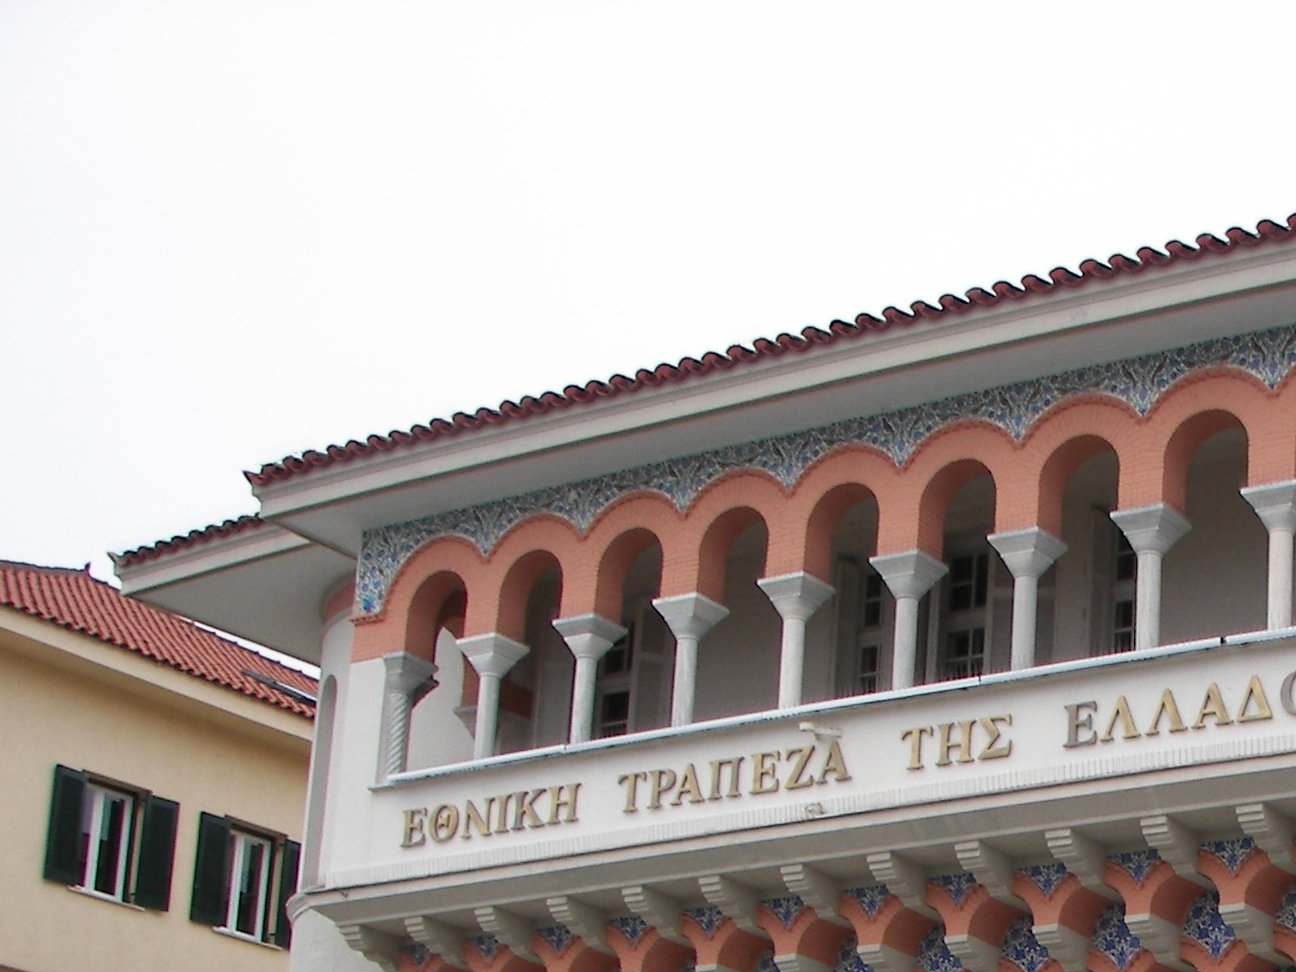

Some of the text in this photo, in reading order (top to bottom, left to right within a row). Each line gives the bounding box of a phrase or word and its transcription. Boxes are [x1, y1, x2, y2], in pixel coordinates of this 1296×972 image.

[399, 782, 582, 849] ΕΘΝΙΚΗ
[617, 738, 852, 814] ΤΡΑΠΕΖΑ
[901, 713, 1014, 770] ΤΗΣ
